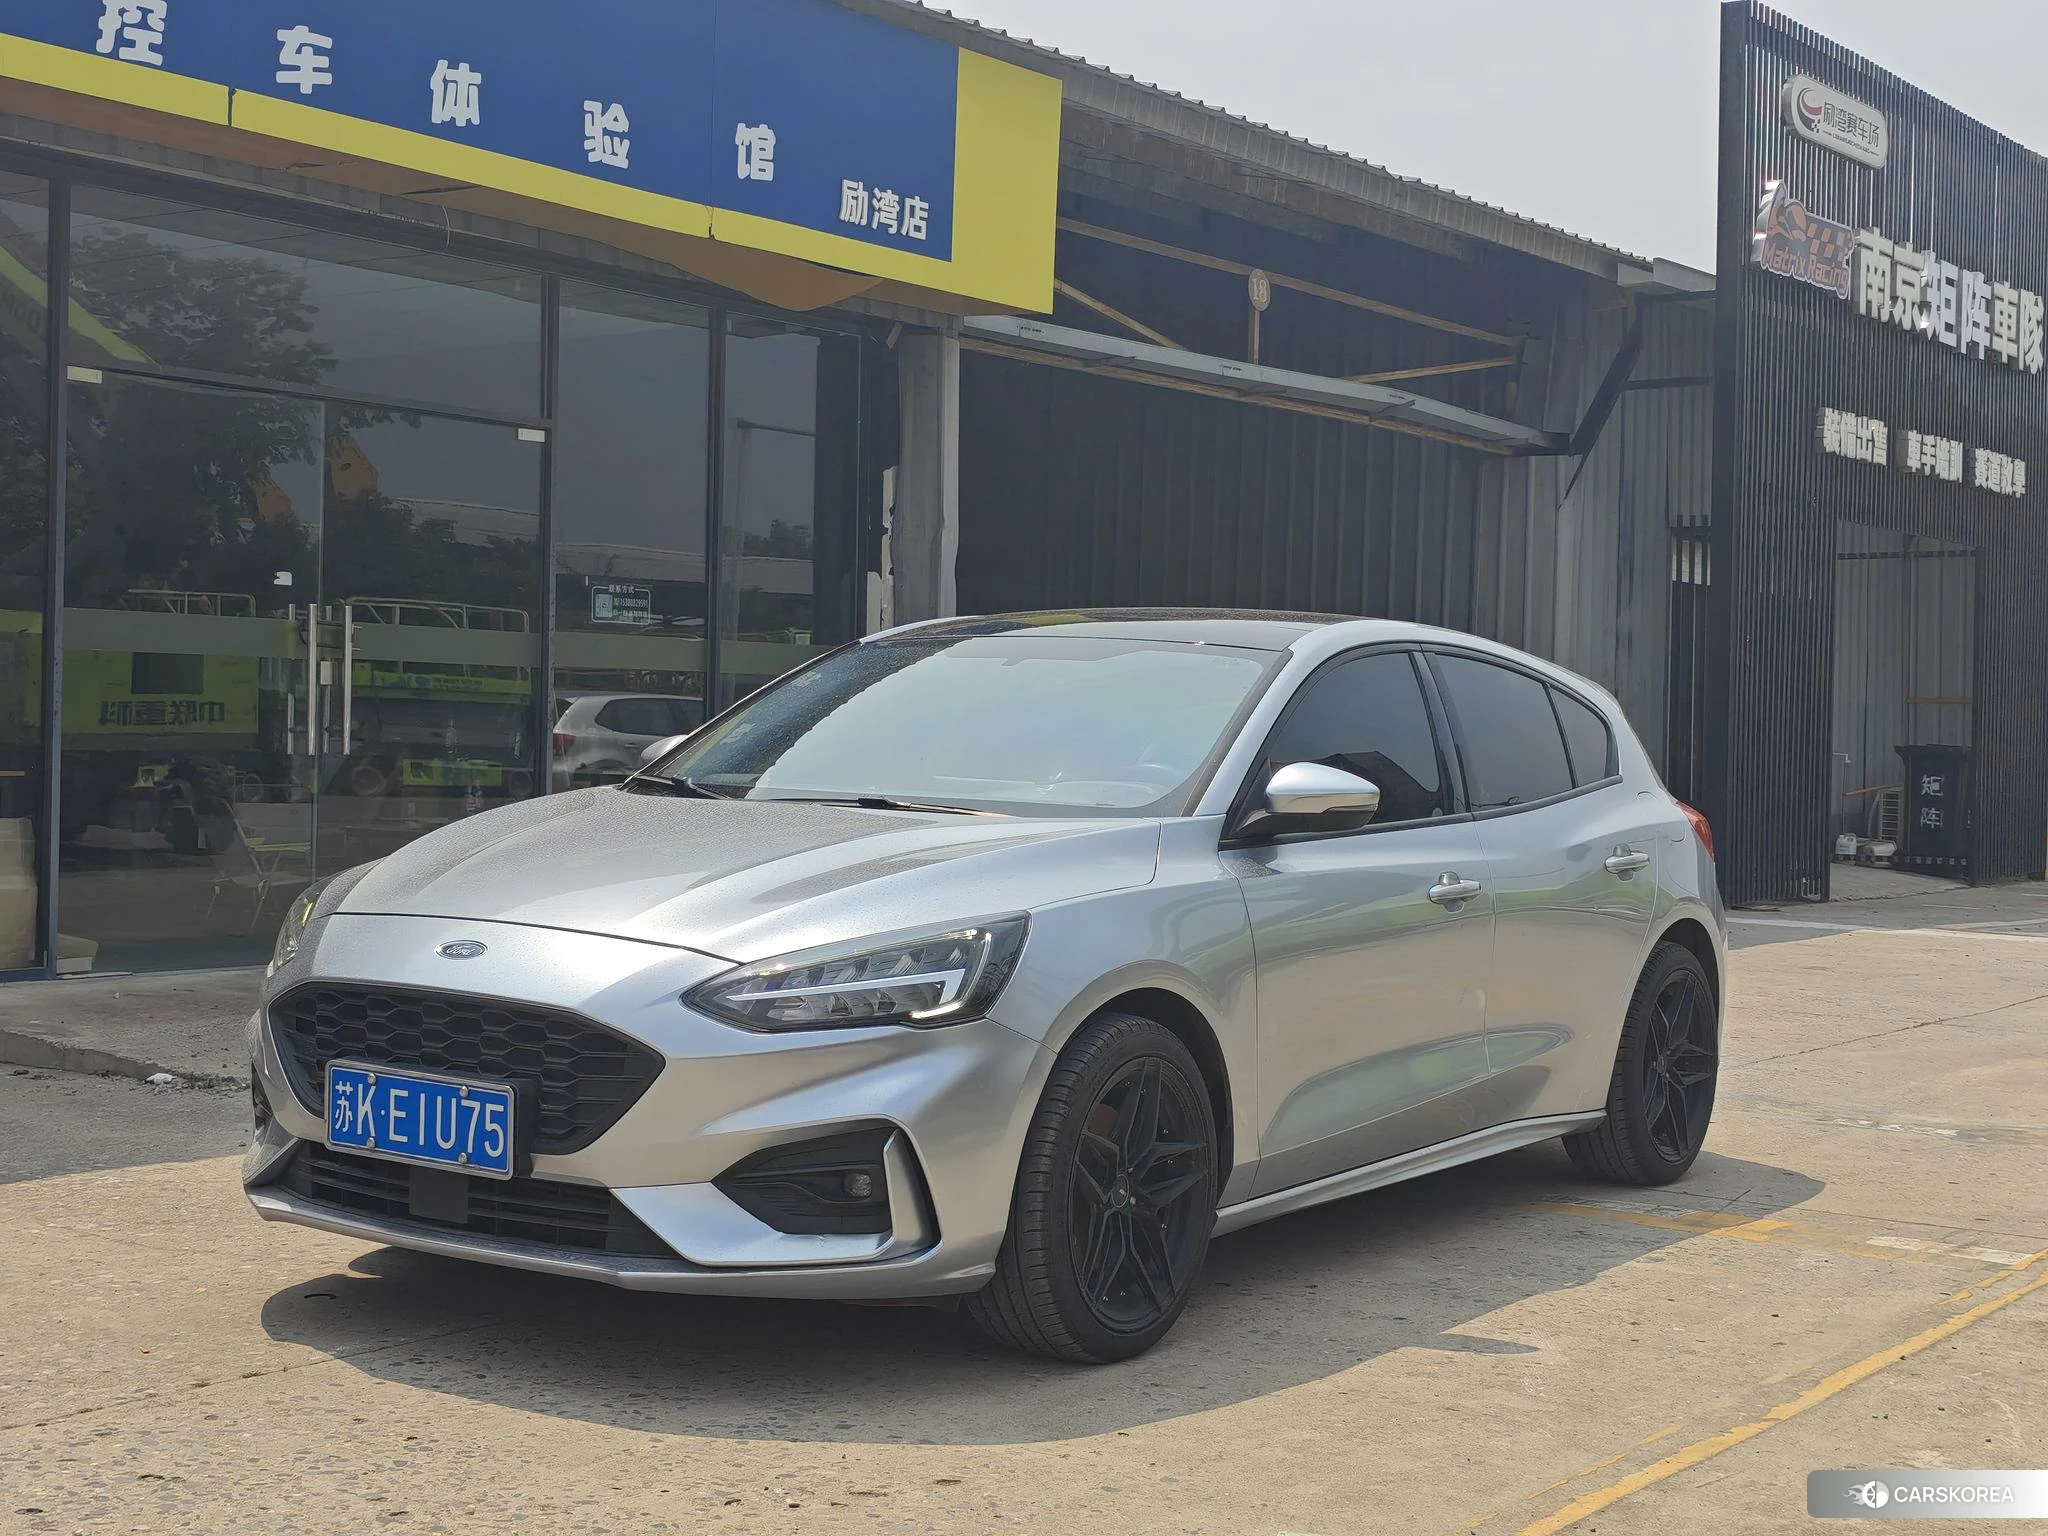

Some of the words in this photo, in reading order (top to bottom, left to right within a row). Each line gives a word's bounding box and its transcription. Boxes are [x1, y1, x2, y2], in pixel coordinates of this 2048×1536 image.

[96, 0, 776, 182] 控车体验馆
[838, 178, 929, 240] 励湾店
[1763, 240, 1806, 278] Matrix
[1807, 253, 1849, 295] Racing
